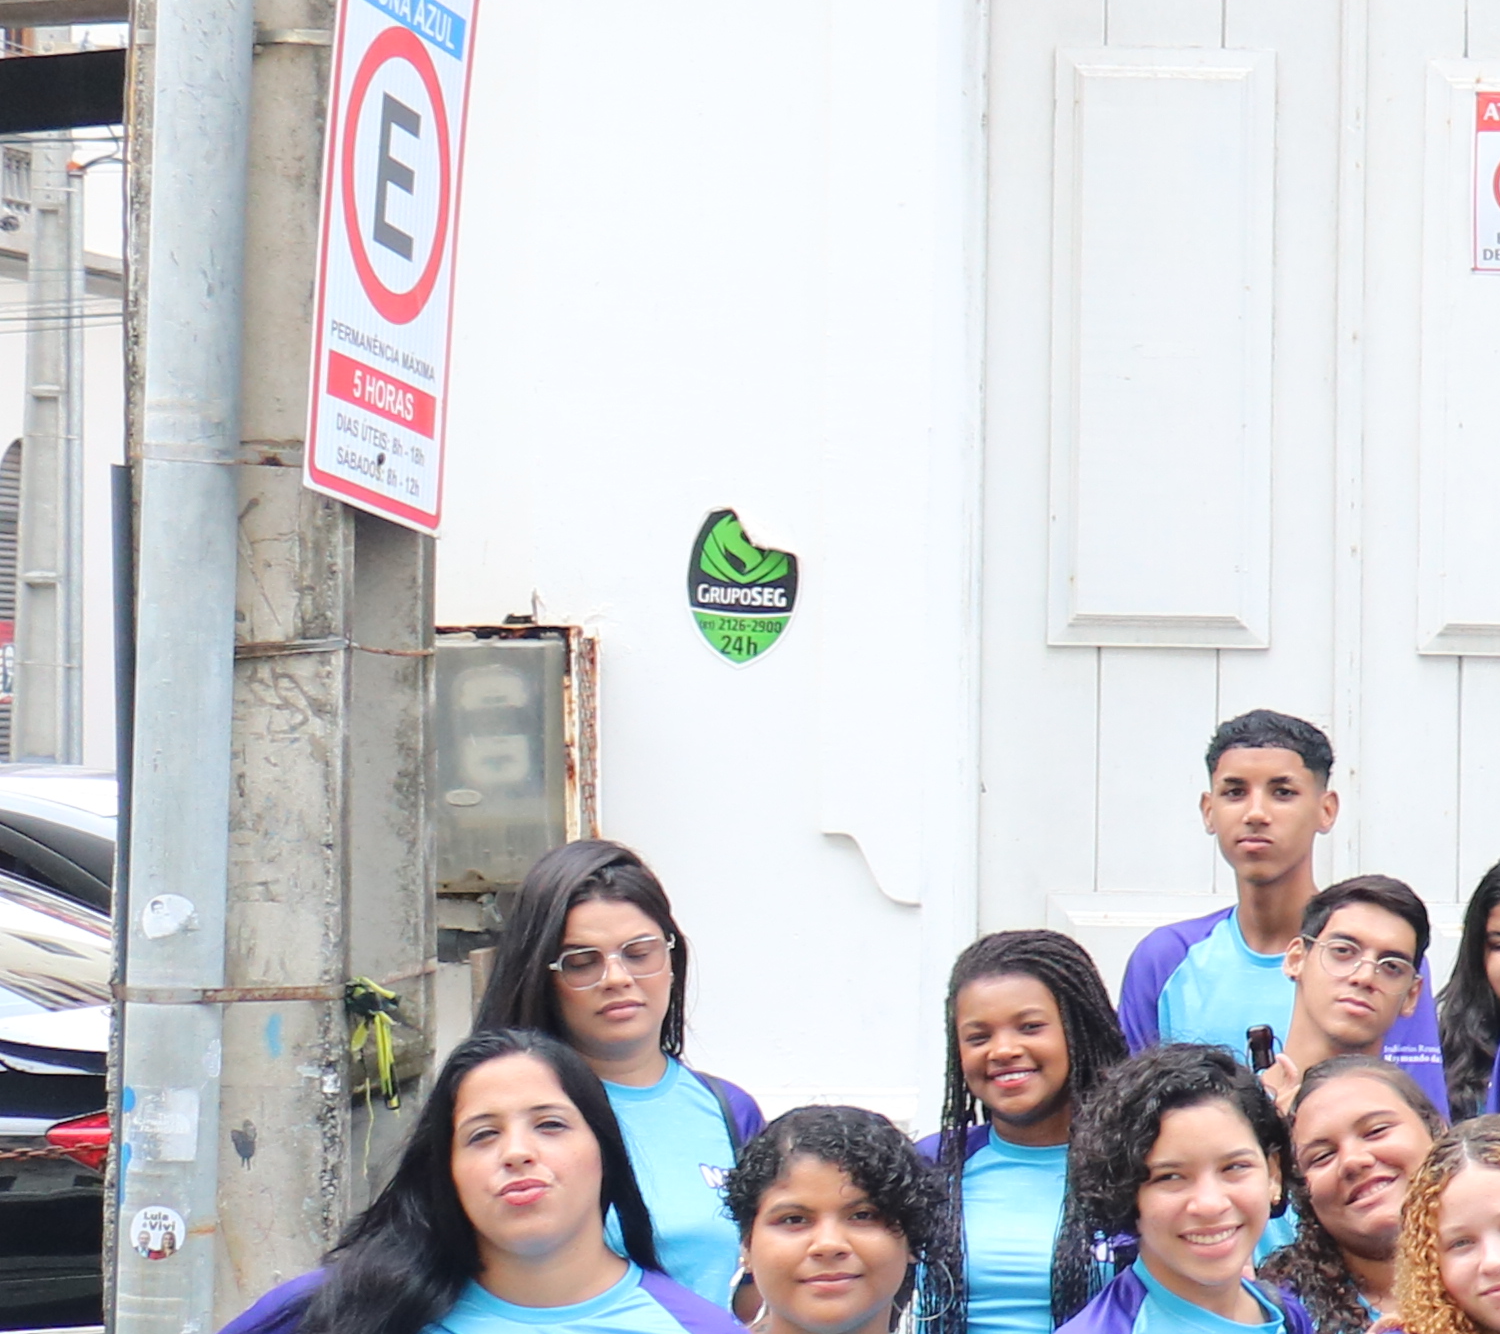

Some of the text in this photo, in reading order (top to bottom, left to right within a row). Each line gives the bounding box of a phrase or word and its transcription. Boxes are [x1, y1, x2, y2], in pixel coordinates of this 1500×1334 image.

[372, 91, 421, 262] E
[330, 319, 435, 382] PERMANÊNCIA MÁXIMA
[352, 370, 414, 421] 5 HORAS
[336, 412, 358, 438] DIAS
[697, 584, 787, 607] GRUPOSEG
[719, 618, 782, 634] 2126-2900
[143, 1211, 169, 1221] Lula
[149, 1221, 176, 1231] Vivi
